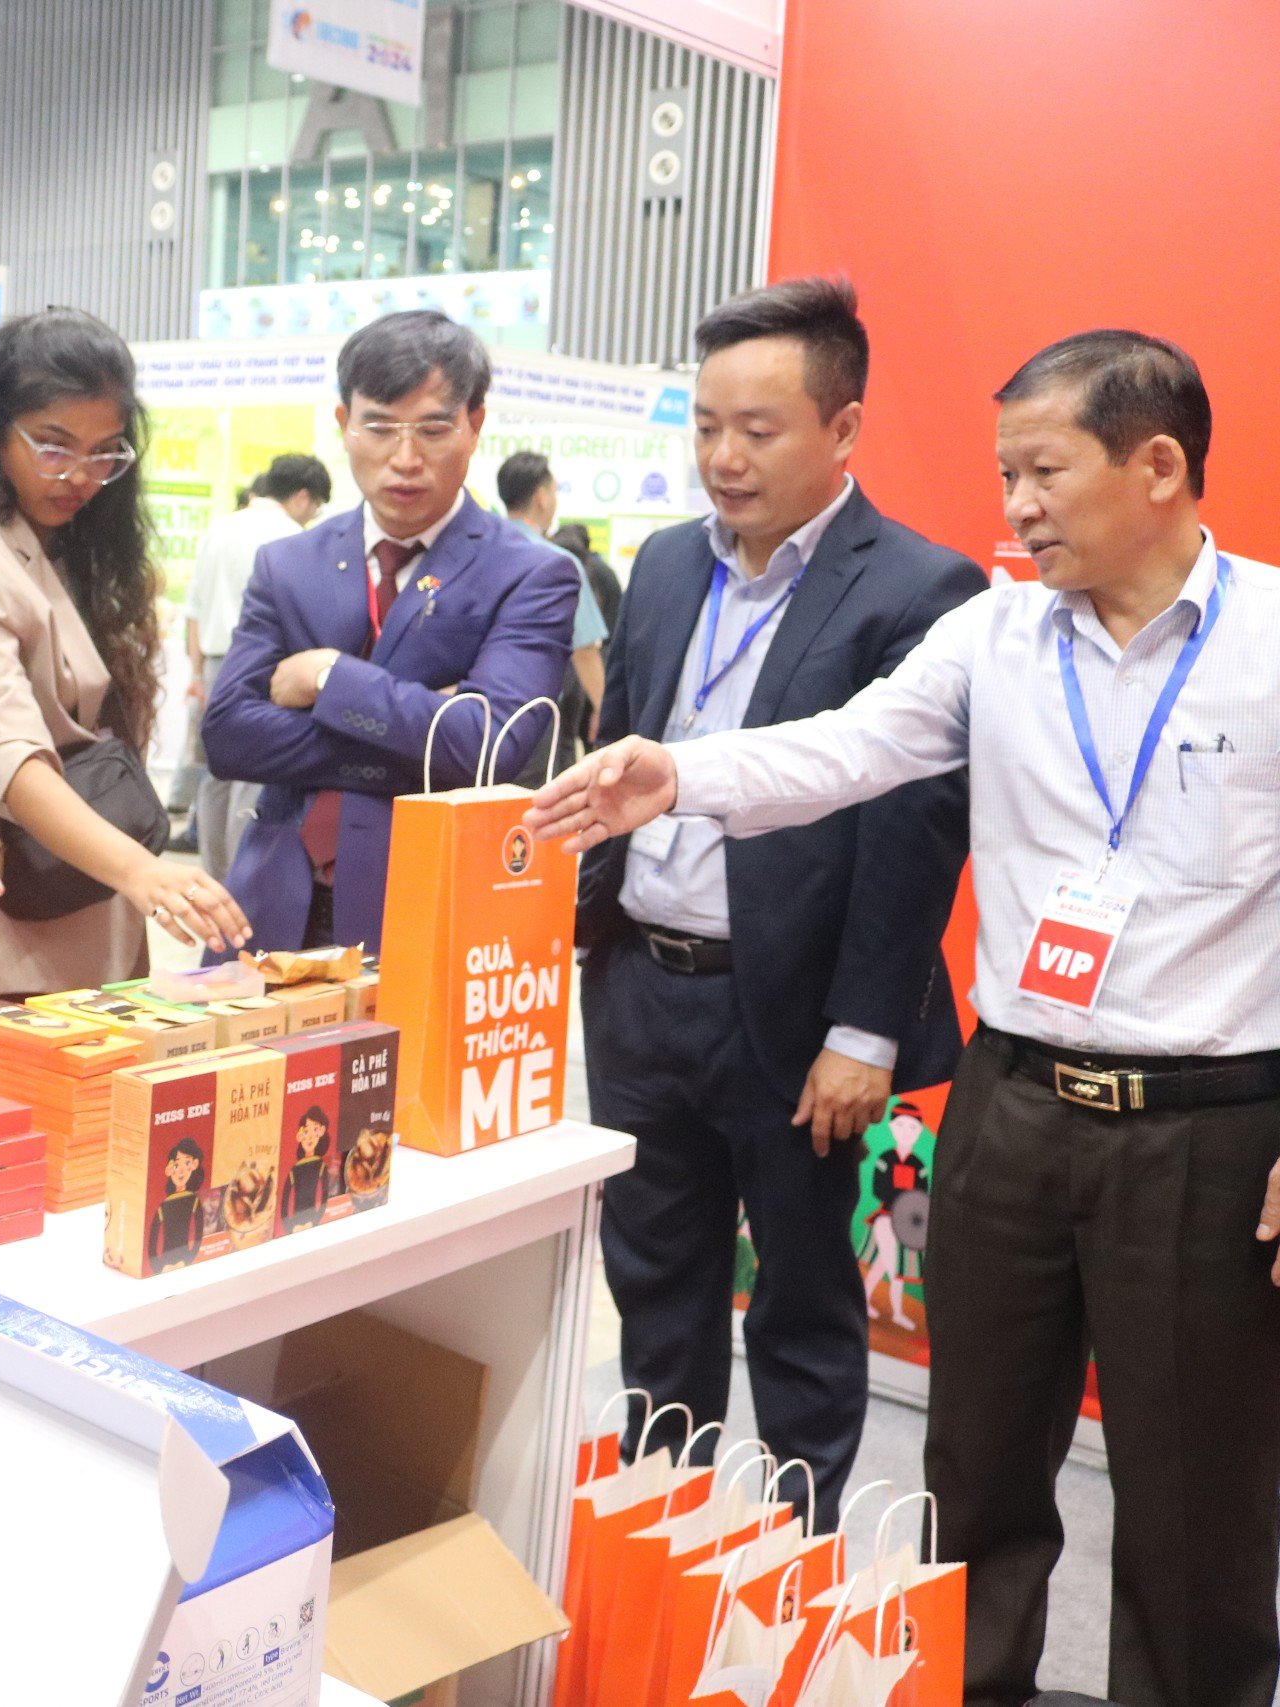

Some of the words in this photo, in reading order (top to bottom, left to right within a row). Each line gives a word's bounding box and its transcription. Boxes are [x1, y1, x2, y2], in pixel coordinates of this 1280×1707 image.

[465, 935, 515, 975] QUÀ
[1039, 941, 1095, 980] VIP
[464, 961, 561, 1026] BUÔN
[464, 1021, 530, 1062] THÍCH
[352, 1053, 366, 1075] CÀ
[287, 1078, 313, 1095] MISS
[314, 1072, 337, 1088] EDE
[371, 1071, 388, 1089] TAN
[459, 1031, 555, 1152] MÊ
[231, 1084, 246, 1104] CÀ
[154, 1108, 185, 1126] MISS
[187, 1102, 211, 1121] EDE
[252, 1101, 270, 1119] TAN
